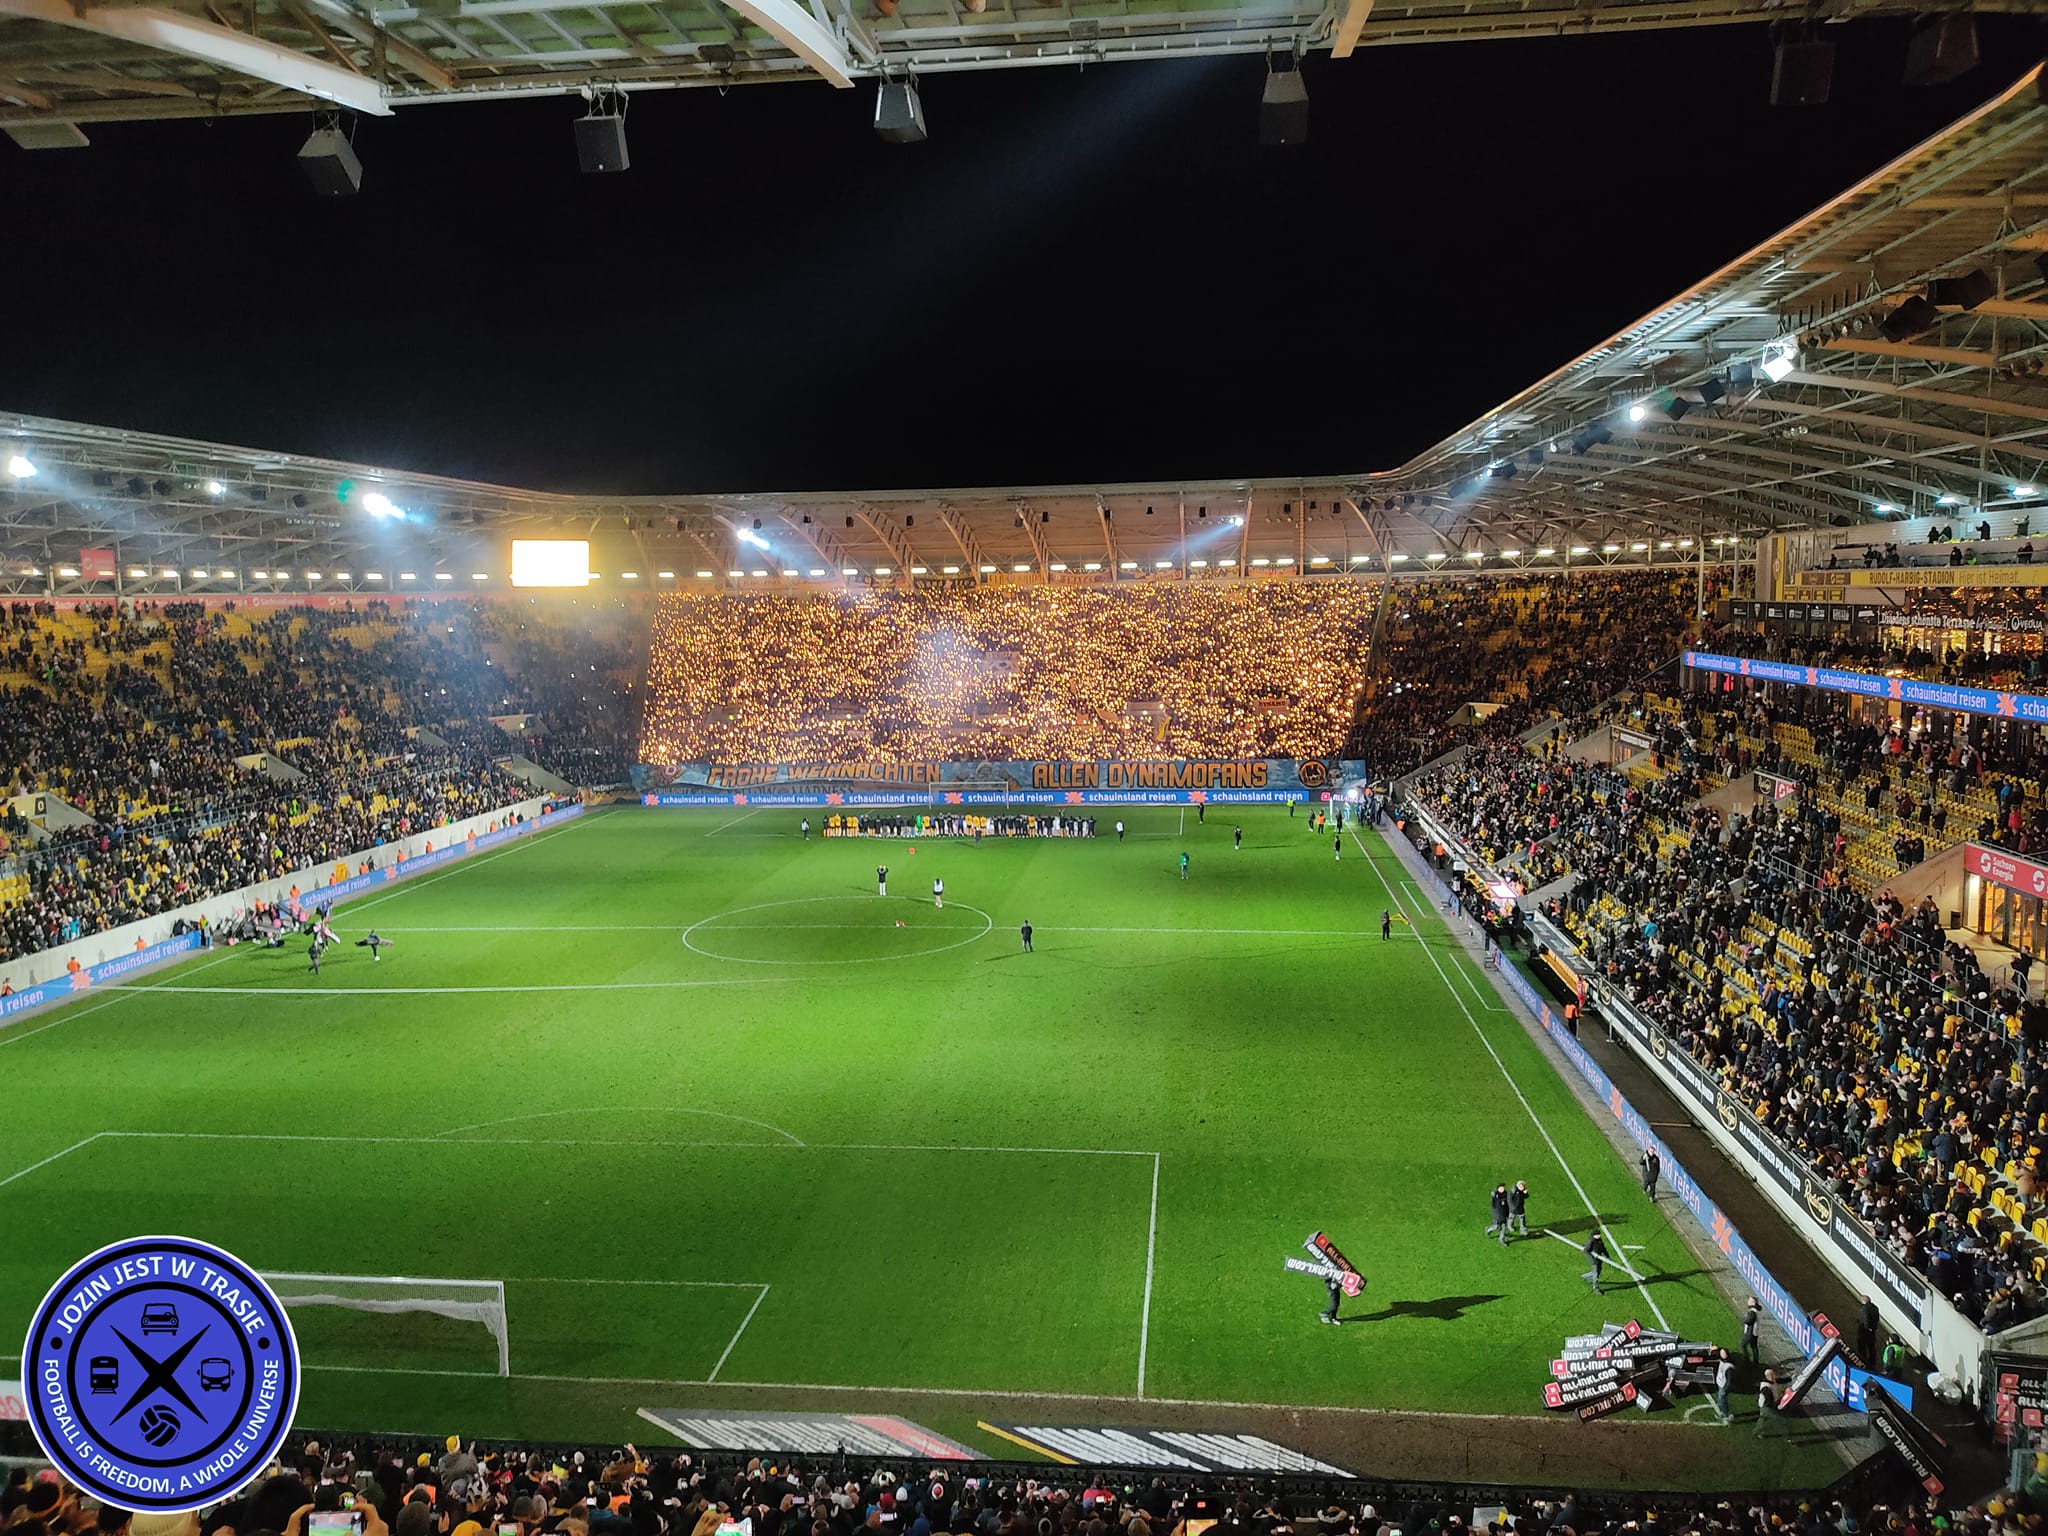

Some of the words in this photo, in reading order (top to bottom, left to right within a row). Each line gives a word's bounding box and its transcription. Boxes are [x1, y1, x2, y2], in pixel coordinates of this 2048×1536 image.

[1869, 571, 1955, 585] RUDOLF-HARBIG-STADION
[1820, 673, 1859, 690] schauinsland
[1860, 677, 1881, 693] reisen
[1906, 684, 1957, 705] schauinsland
[1959, 691, 1986, 709] reisen
[707, 766, 778, 788] FROHE
[788, 762, 941, 783] WEIHNACHTEN
[1033, 763, 1099, 788] ALLEN
[1108, 762, 1268, 788] DYNAMOFANS
[663, 795, 706, 804] schauinsland
[707, 795, 729, 804] reisen
[751, 794, 795, 803] schauinsland
[796, 795, 818, 803] reisen
[849, 793, 904, 803] schauinsland
[906, 793, 933, 803] reisen
[1026, 792, 1054, 802] reisen
[1089, 791, 1147, 802] schauinsland
[1149, 791, 1177, 802] reisen
[1212, 791, 1272, 802] schauinsland
[1274, 791, 1303, 801] reisen
[305, 882, 350, 906] schauinsland
[350, 876, 371, 893] reisen
[98, 946, 161, 979] schauinsland
[162, 938, 190, 957] reisen
[6, 989, 43, 1012] reisen
[1626, 1111, 1673, 1179] schauinland
[1673, 1168, 1700, 1214] reisen
[1835, 1216, 1887, 1279] RADEBERGER
[1887, 1267, 1923, 1314] PILSNER
[1737, 1248, 1811, 1354] schauinsland
[1570, 1358, 1633, 1372] ALL-INKLCOM
